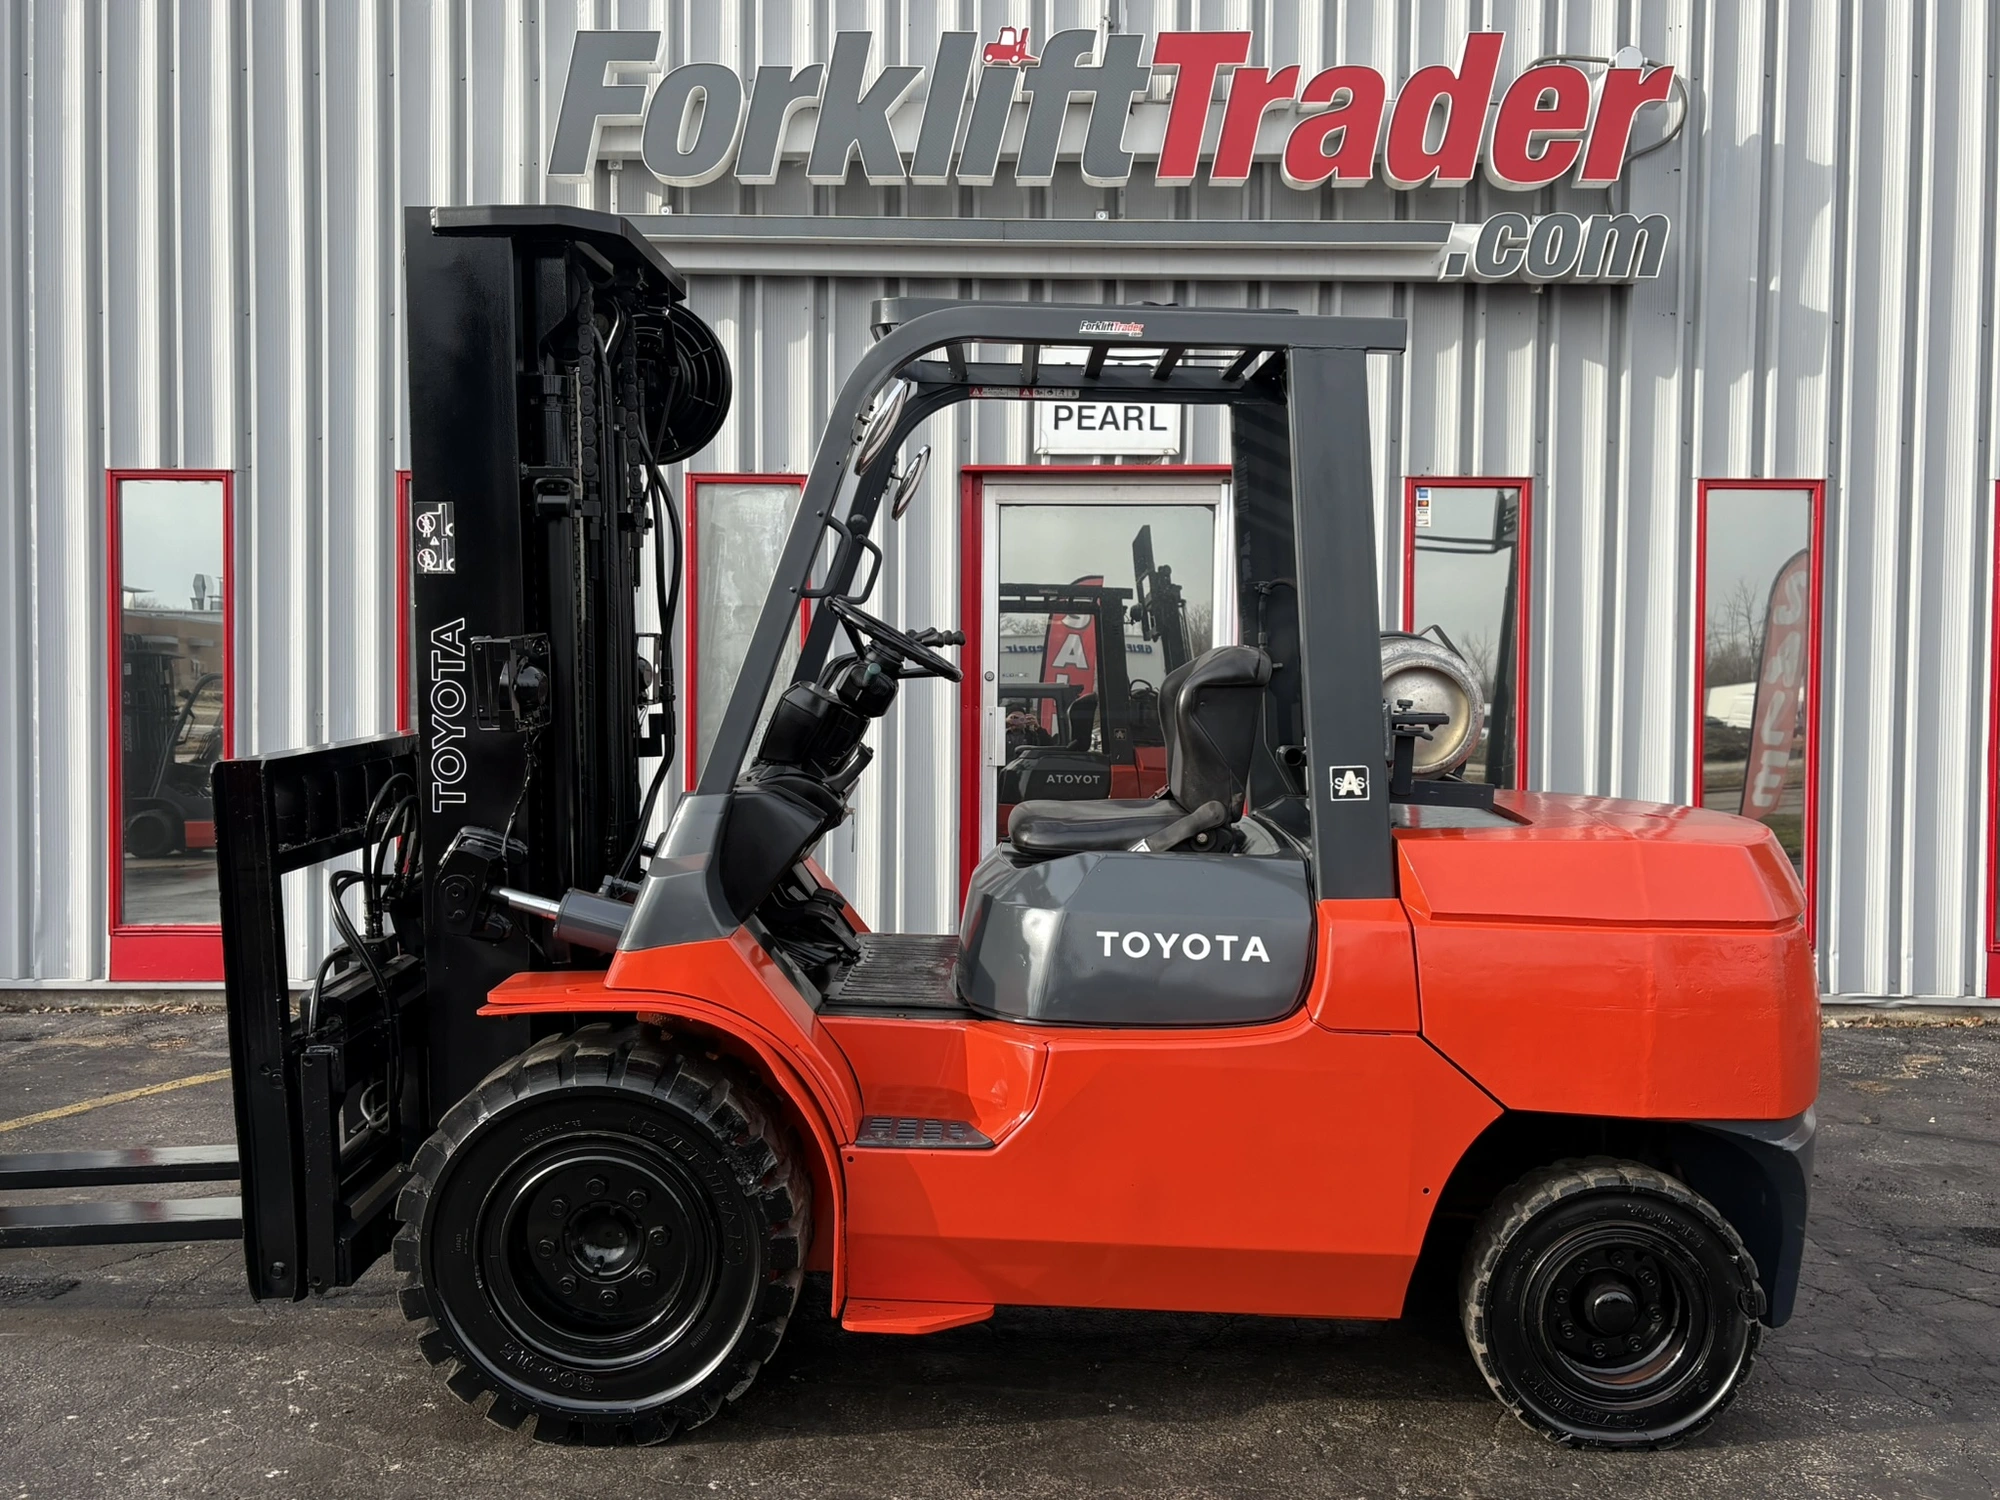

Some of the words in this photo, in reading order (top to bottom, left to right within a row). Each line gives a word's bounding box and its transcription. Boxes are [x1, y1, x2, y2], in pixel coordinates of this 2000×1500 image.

[1441, 211, 1672, 280] .com
[1053, 404, 1168, 432] PEARL
[430, 617, 467, 813] TOYOTA
[1096, 930, 1271, 963] TOYOTA
